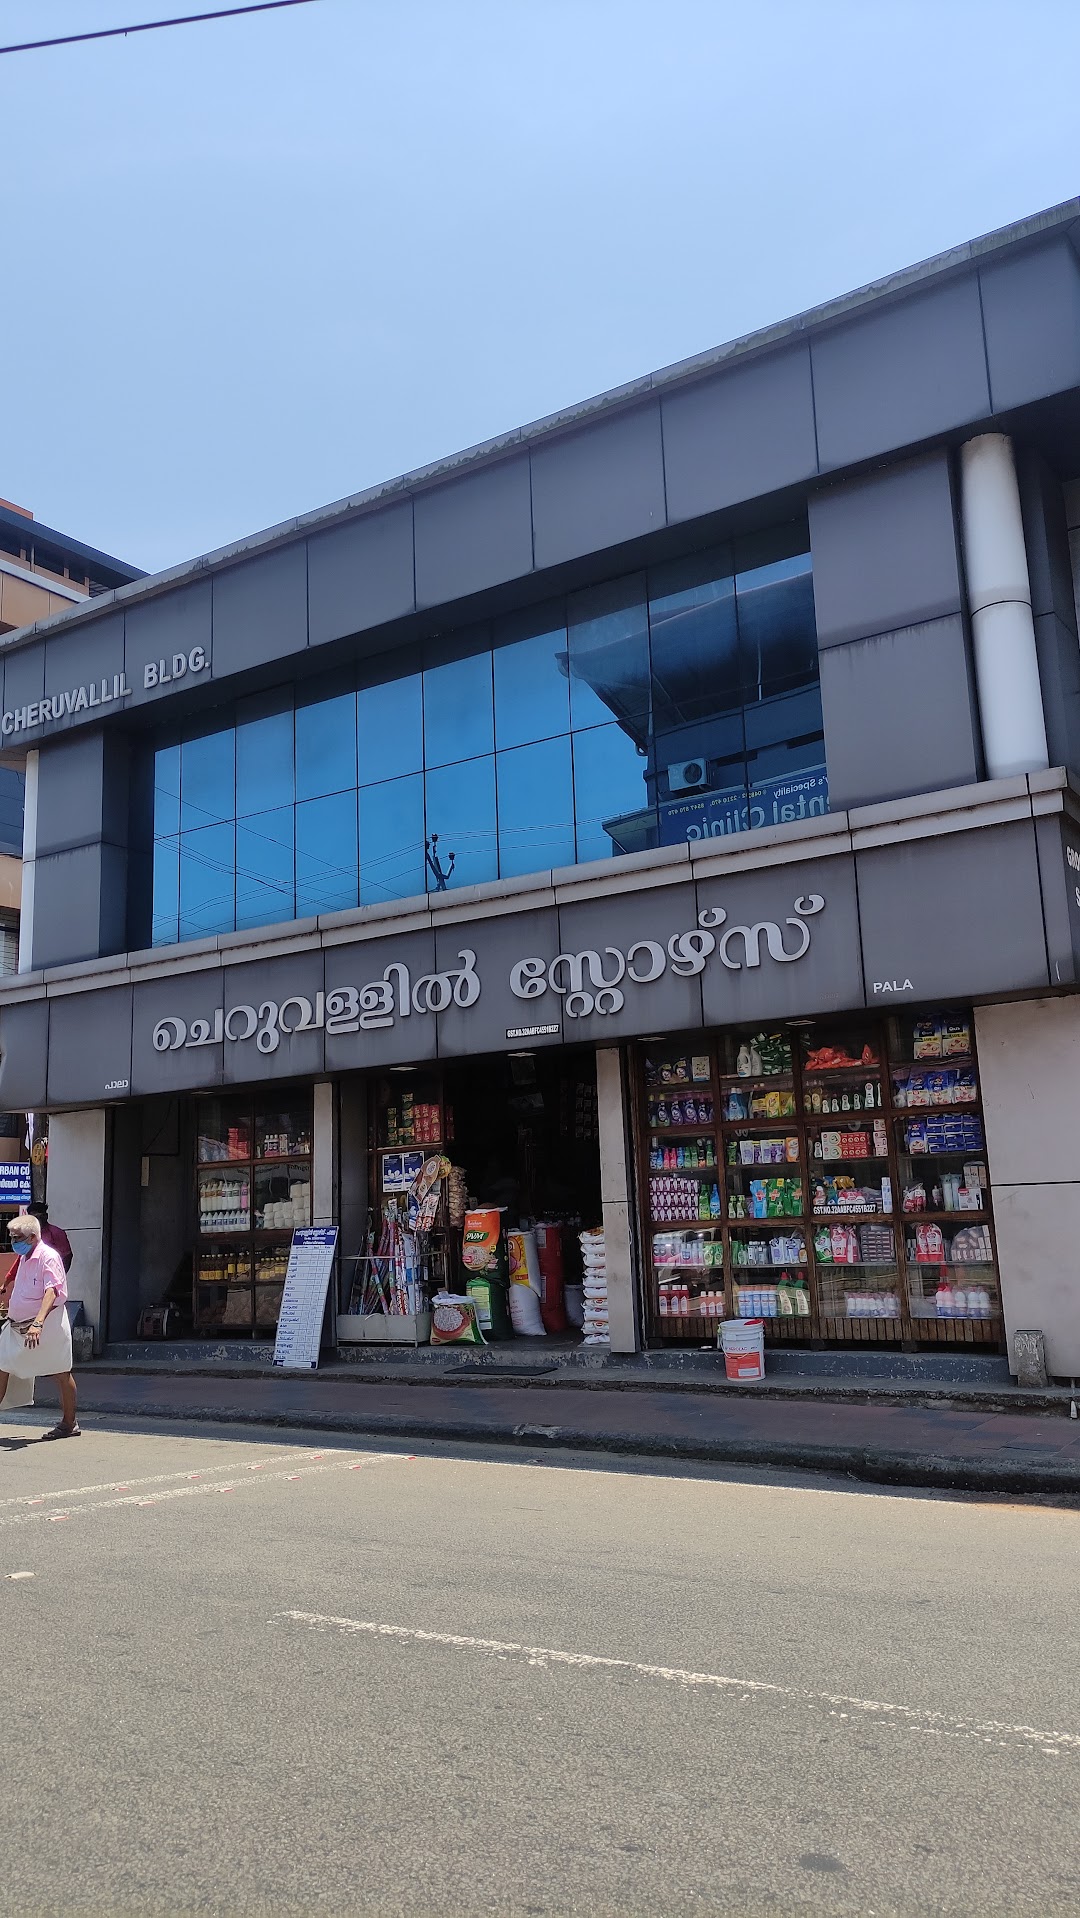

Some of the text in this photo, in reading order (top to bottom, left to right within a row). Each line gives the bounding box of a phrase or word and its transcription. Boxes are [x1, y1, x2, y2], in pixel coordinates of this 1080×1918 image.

[2, 646, 211, 735] CHERUVALLIL BLDG.
[873, 978, 914, 994] PALA
[104, 1079, 129, 1090] പാലാ
